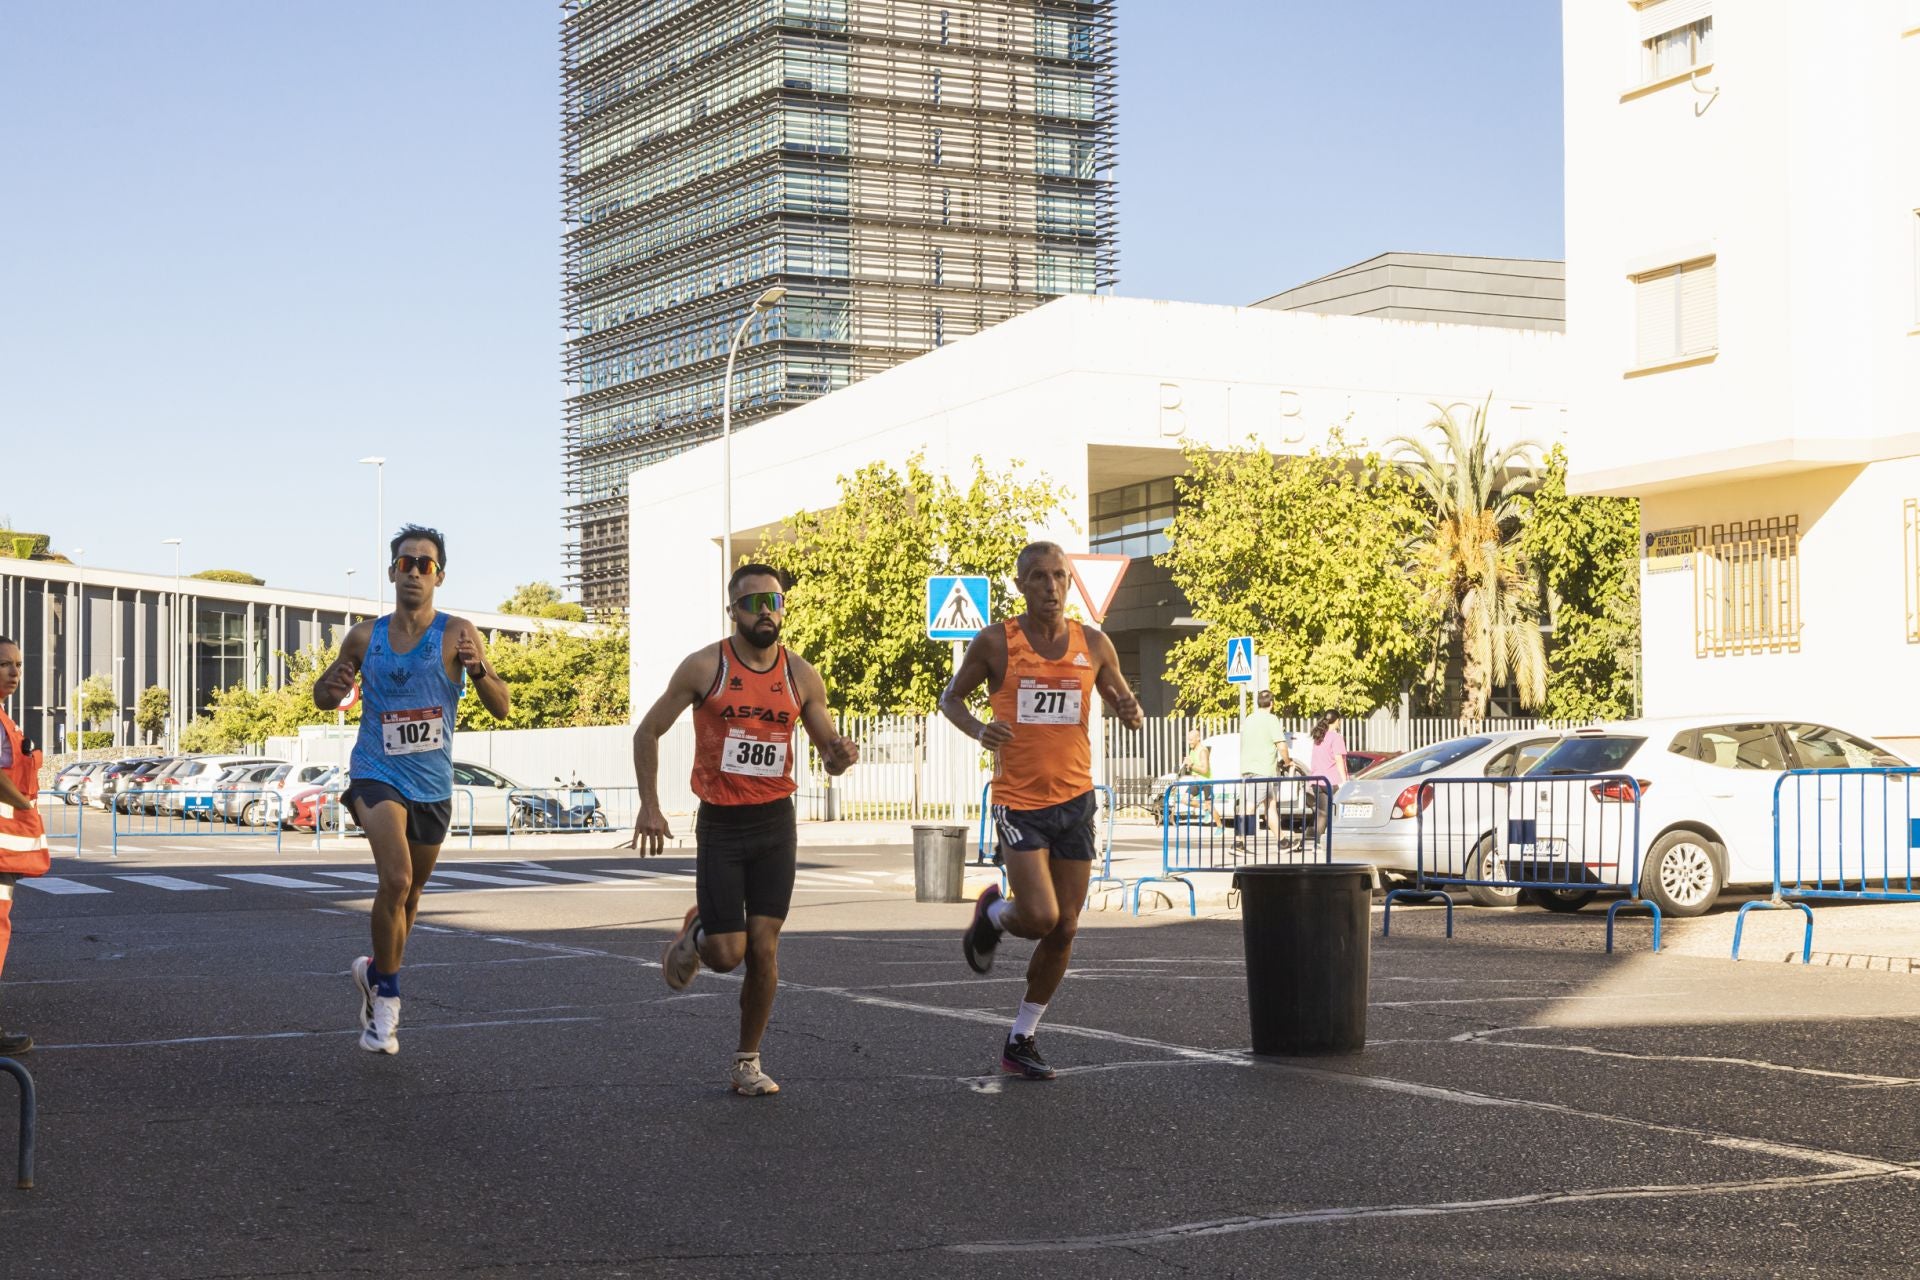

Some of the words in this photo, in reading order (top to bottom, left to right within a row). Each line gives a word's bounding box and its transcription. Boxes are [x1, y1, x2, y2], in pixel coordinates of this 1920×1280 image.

[1656, 545, 1693, 558] DOMINICANA
[1034, 692, 1066, 713] 277
[720, 705, 790, 724] ASFAS
[396, 722, 430, 744] 102
[736, 742, 777, 767] 386
